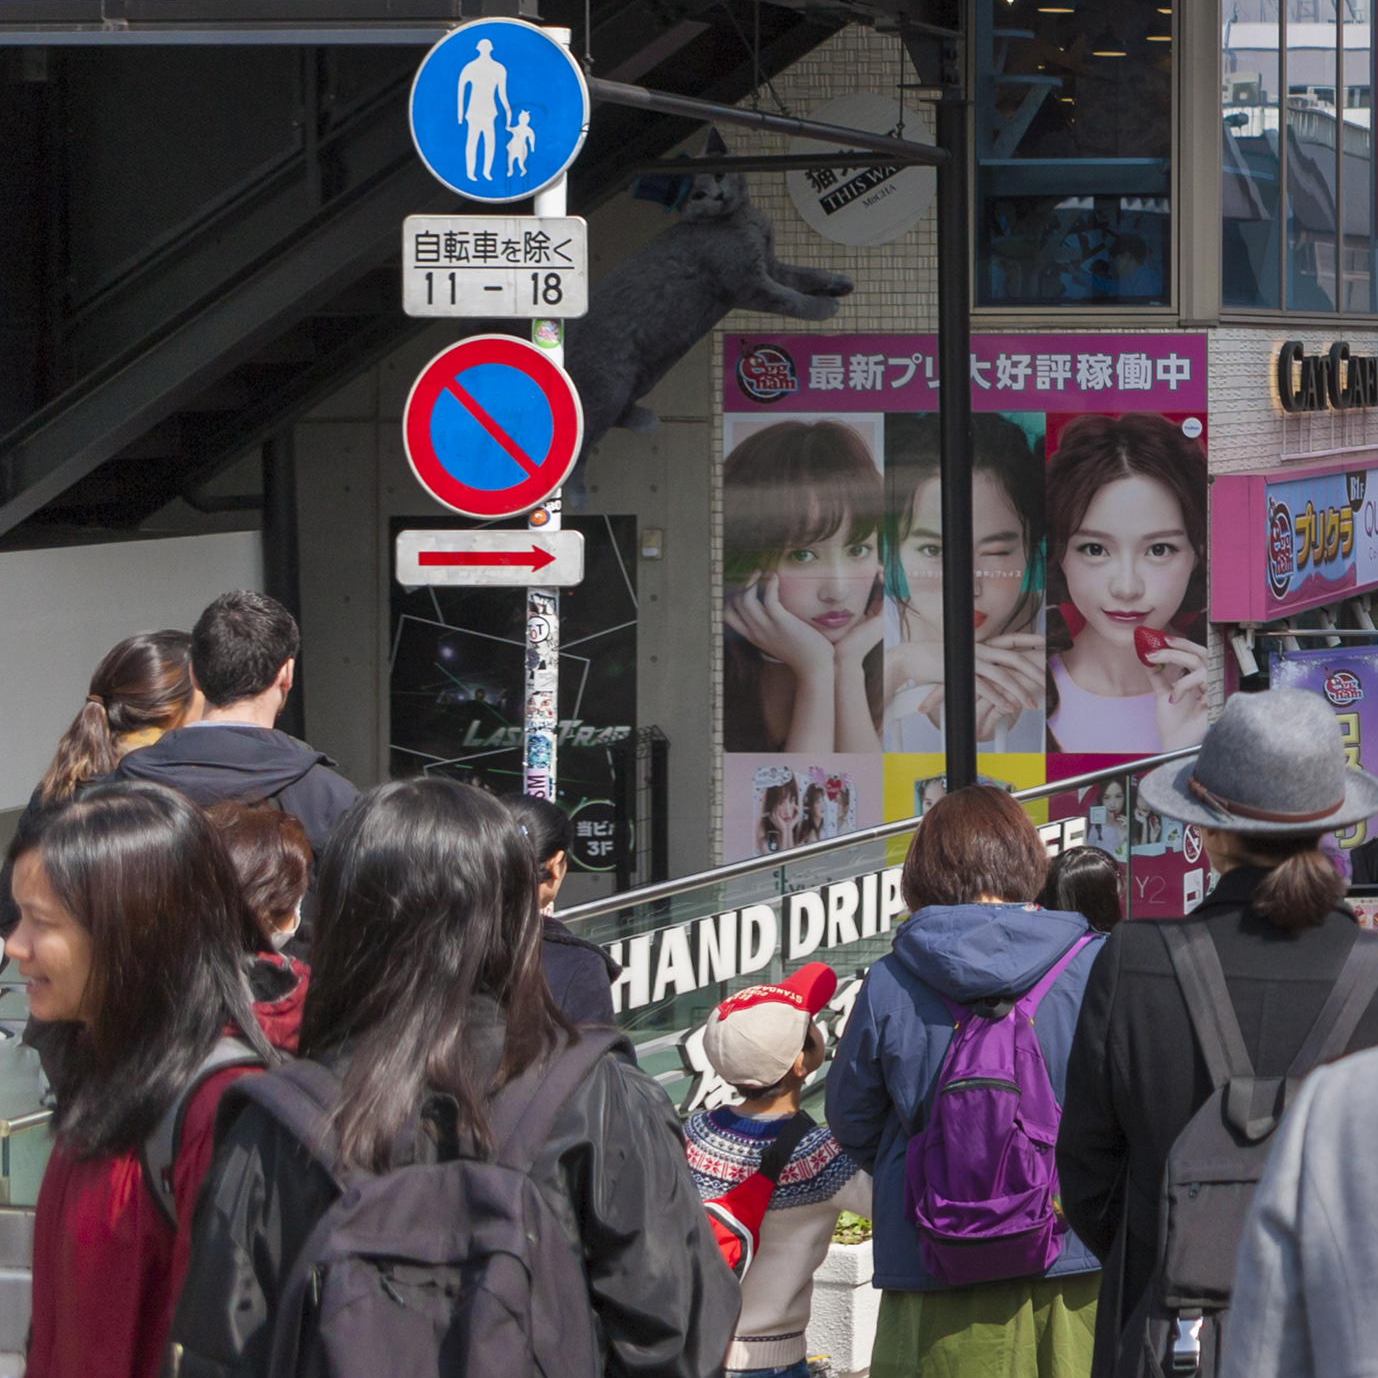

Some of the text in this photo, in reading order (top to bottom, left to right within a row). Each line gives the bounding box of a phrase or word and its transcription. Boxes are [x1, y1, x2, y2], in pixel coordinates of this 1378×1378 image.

[414, 230, 574, 265] 自転車を除く
[424, 271, 457, 307] 11
[531, 271, 563, 307] 18
[1294, 499, 1355, 570] プリクラ
[586, 841, 614, 856] 3F
[608, 867, 908, 1014] HAND DRIP
